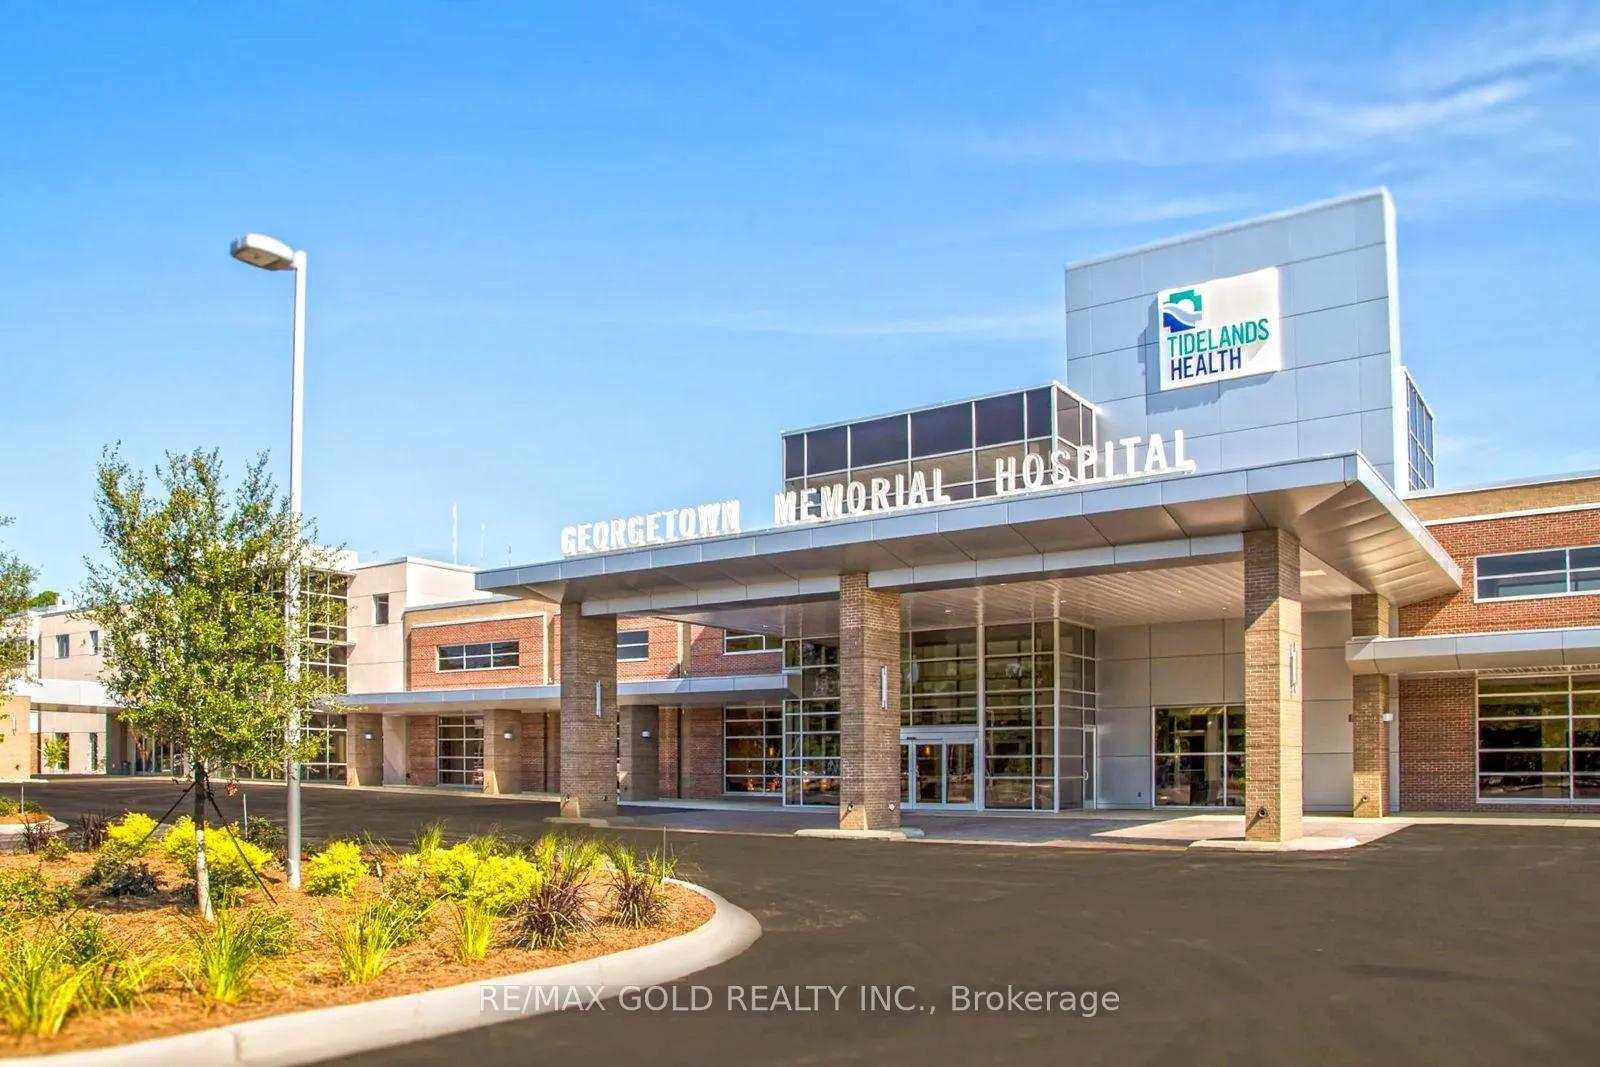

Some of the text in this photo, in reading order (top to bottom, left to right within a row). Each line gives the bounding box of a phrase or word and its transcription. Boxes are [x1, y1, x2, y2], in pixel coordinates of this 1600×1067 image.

[1167, 318, 1269, 357] TIDELANDS
[1171, 347, 1241, 380] HEALTH
[560, 429, 1197, 556] GEORGETOWN MEMORIAL HOSPITAL
